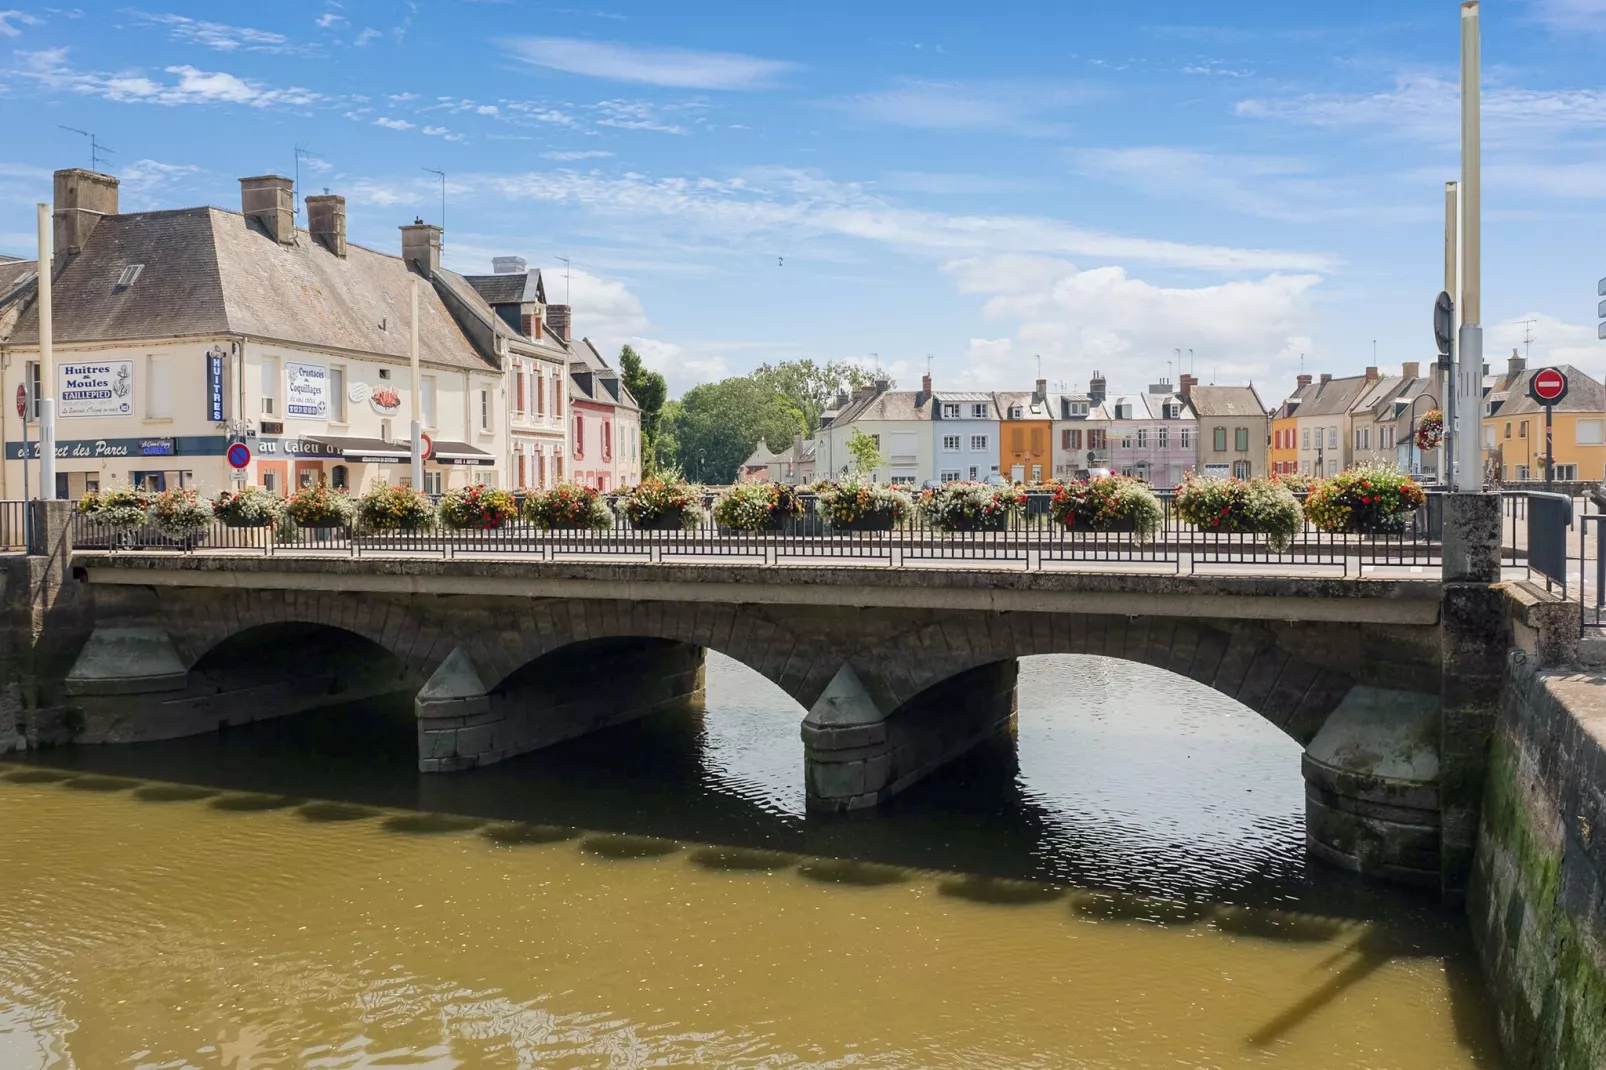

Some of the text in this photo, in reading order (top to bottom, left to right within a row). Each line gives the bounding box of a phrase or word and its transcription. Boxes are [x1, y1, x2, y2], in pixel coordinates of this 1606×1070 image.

[65, 366, 110, 375] Huitres
[299, 367, 324, 379] Crustacés
[66, 379, 109, 388] Moules
[213, 358, 221, 420] HUITRES
[290, 382, 321, 396] Coquillages
[64, 391, 110, 399] TAILLEPIED
[73, 443, 91, 456] des
[95, 440, 128, 456] Parcs
[143, 447, 168, 455] OUVERT
[259, 441, 276, 452] au
[284, 440, 319, 454] Caïeu
